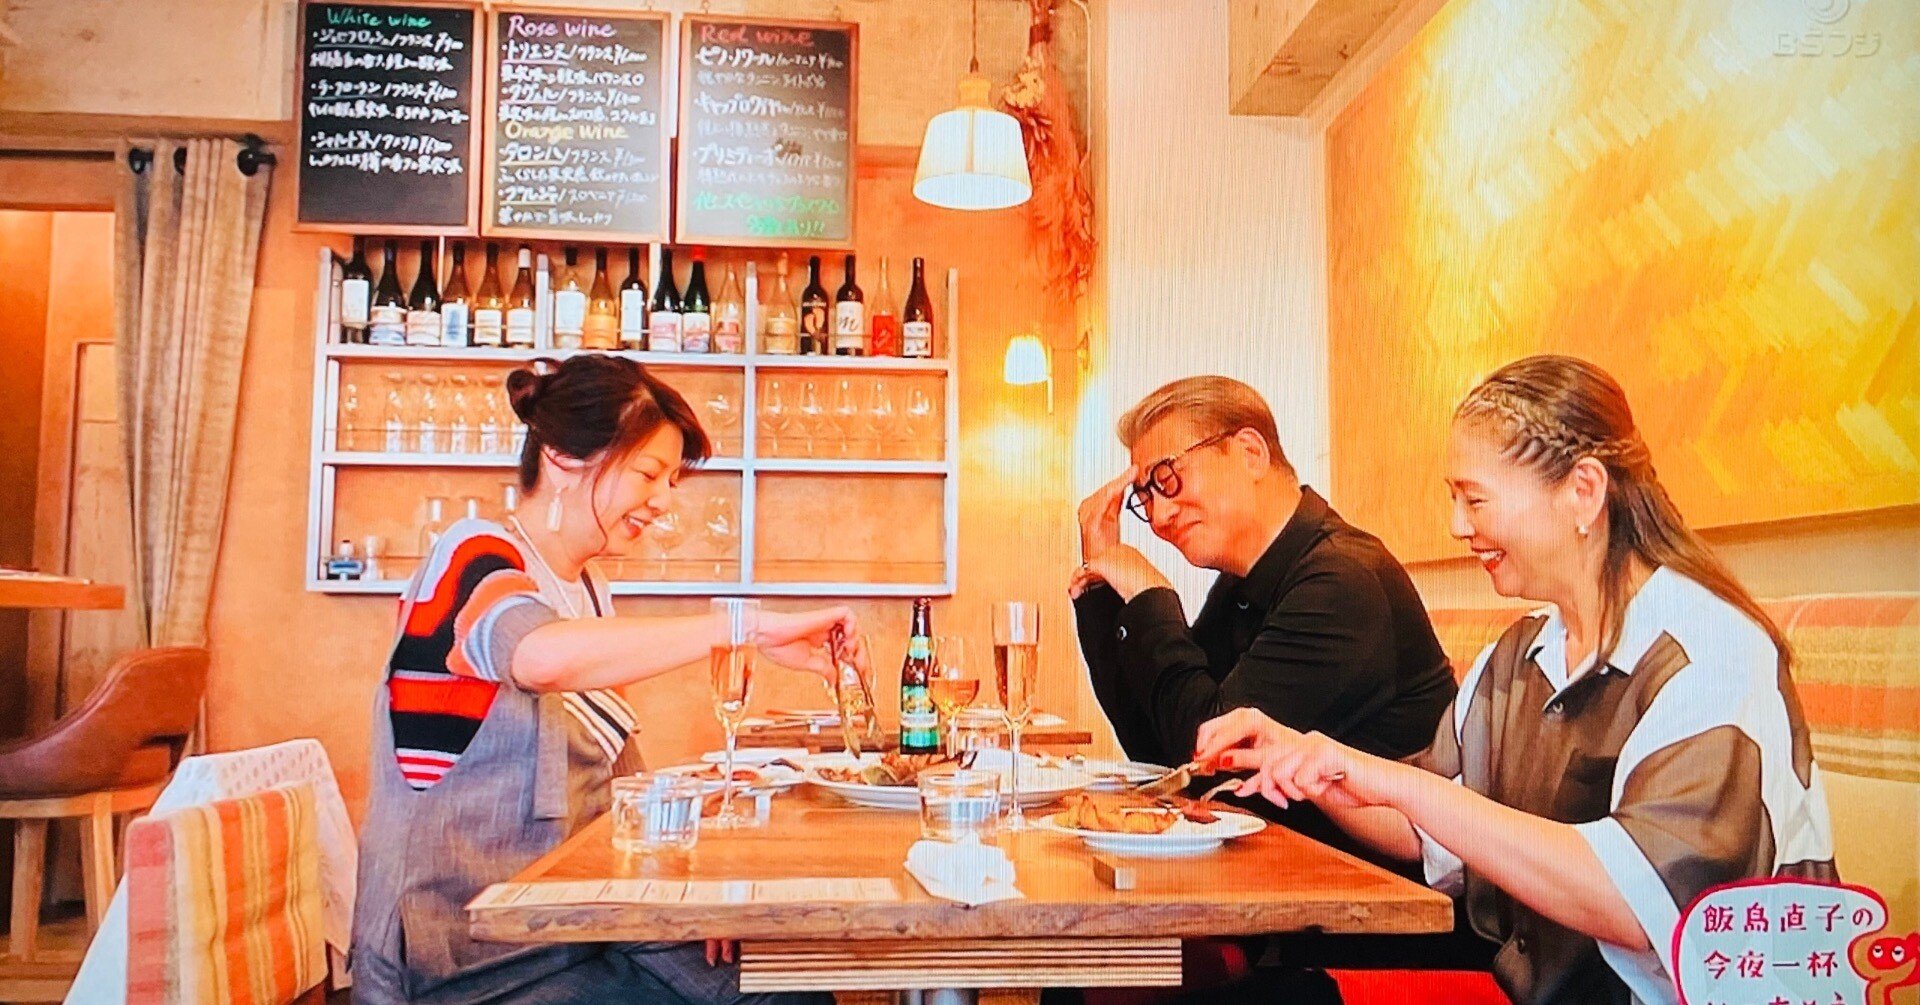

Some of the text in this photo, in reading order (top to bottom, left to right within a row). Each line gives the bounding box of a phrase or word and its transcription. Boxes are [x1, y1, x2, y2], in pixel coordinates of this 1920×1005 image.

[327, 7, 432, 28] White wine
[508, 15, 617, 37] Rose wine
[701, 24, 814, 46] Red wine
[505, 121, 575, 144] Orange
